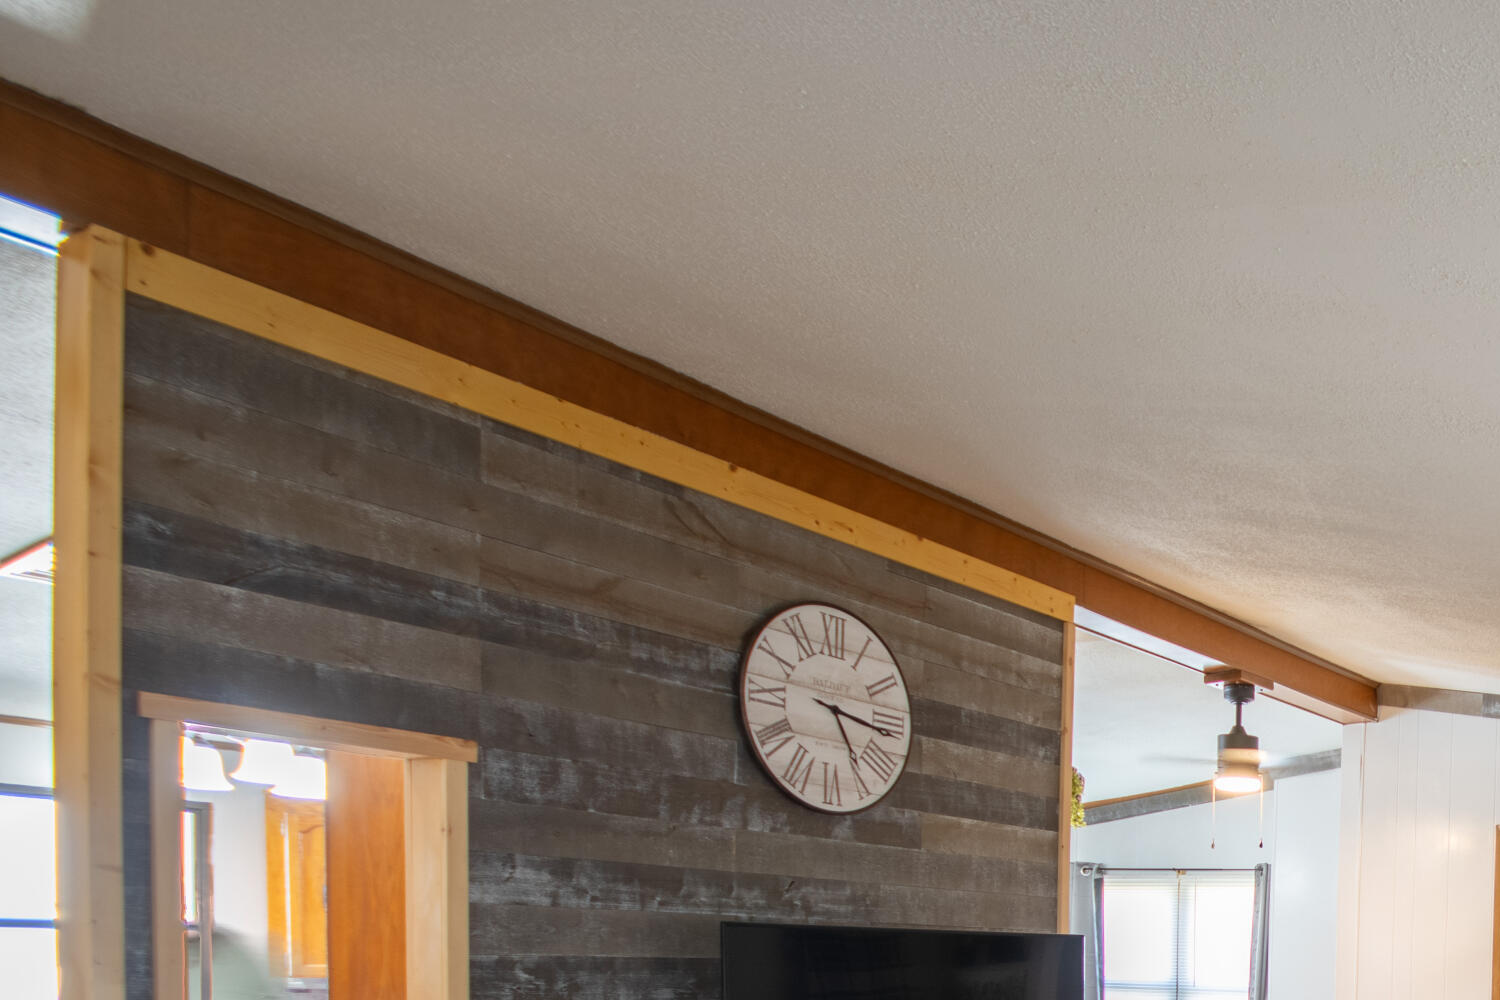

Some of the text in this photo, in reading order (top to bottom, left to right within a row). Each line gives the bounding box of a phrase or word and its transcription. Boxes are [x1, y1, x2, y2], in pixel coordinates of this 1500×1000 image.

[756, 635, 796, 679] X
[781, 612, 818, 662] XI
[819, 611, 848, 661] XII
[850, 635, 873, 671] I
[748, 678, 787, 711] IX
[866, 672, 898, 698] II
[781, 743, 816, 796] VII
